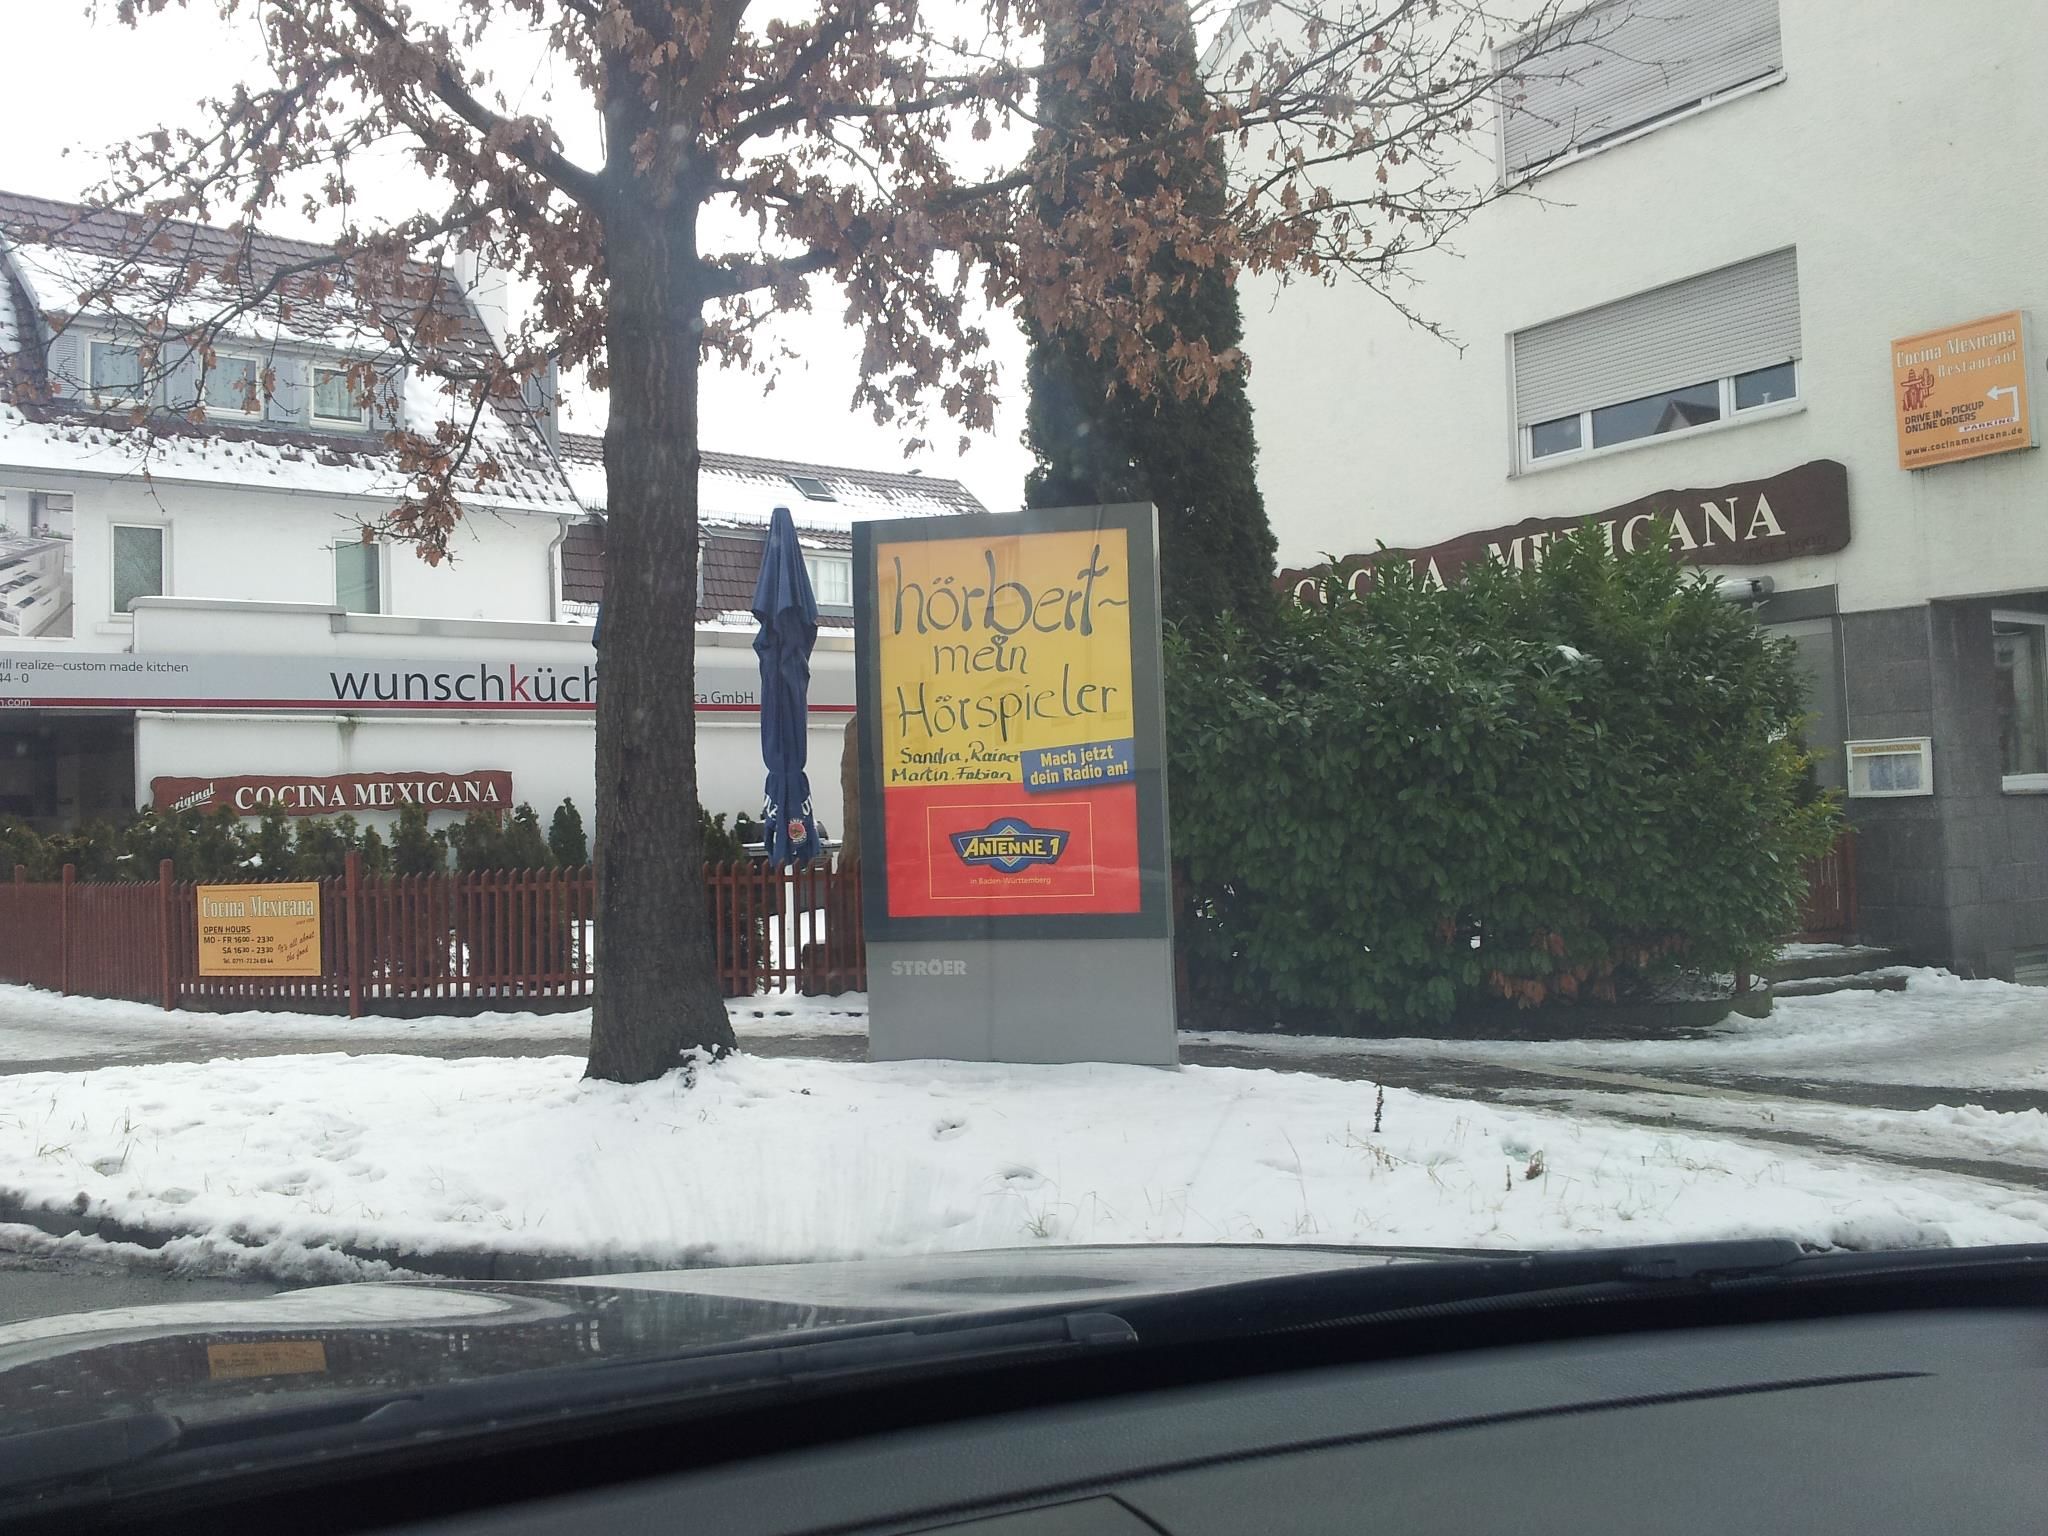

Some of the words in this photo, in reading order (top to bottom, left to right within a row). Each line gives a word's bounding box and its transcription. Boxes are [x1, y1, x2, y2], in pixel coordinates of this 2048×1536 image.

[1896, 346, 1942, 368] Cocina
[1947, 328, 2016, 354] Mexicana
[1938, 350, 2017, 378] Restaurant
[1905, 411, 1931, 425] DRIVE
[1932, 409, 1943, 419] IN
[1951, 401, 1984, 415] PICKUP
[1905, 419, 1938, 434] ONLINE
[1940, 412, 1976, 427] ORDERS
[1905, 427, 2023, 456] www.cocinamexicana.de
[0, 658, 12, 670] ill
[109, 661, 144, 672] made
[146, 662, 189, 673] kitchen
[933, 634, 1028, 675] mein
[21, 673, 30, 684] 0
[711, 691, 754, 704] GmbH
[896, 663, 1118, 742] Hörspieler
[1040, 749, 1077, 768] Mach
[1080, 744, 1114, 766] jetzt
[956, 766, 1012, 782] Fabian
[1030, 769, 1060, 785] dein
[1063, 764, 1103, 782] Radio
[1106, 760, 1129, 777] an!
[169, 782, 216, 812] riginal
[235, 783, 347, 810] COCINA
[354, 780, 501, 807] MEXICANA
[962, 836, 1046, 858] ANTENNE
[1049, 837, 1060, 856] 1
[978, 876, 1052, 886] Baden-Württemberg
[202, 896, 245, 918] Cocina
[249, 895, 315, 917] Mexicana
[203, 925, 224, 934] OPEN
[225, 925, 251, 934] HOURS
[203, 936, 216, 944] MO
[222, 936, 233, 944] FR
[891, 958, 968, 976] STRÖER
